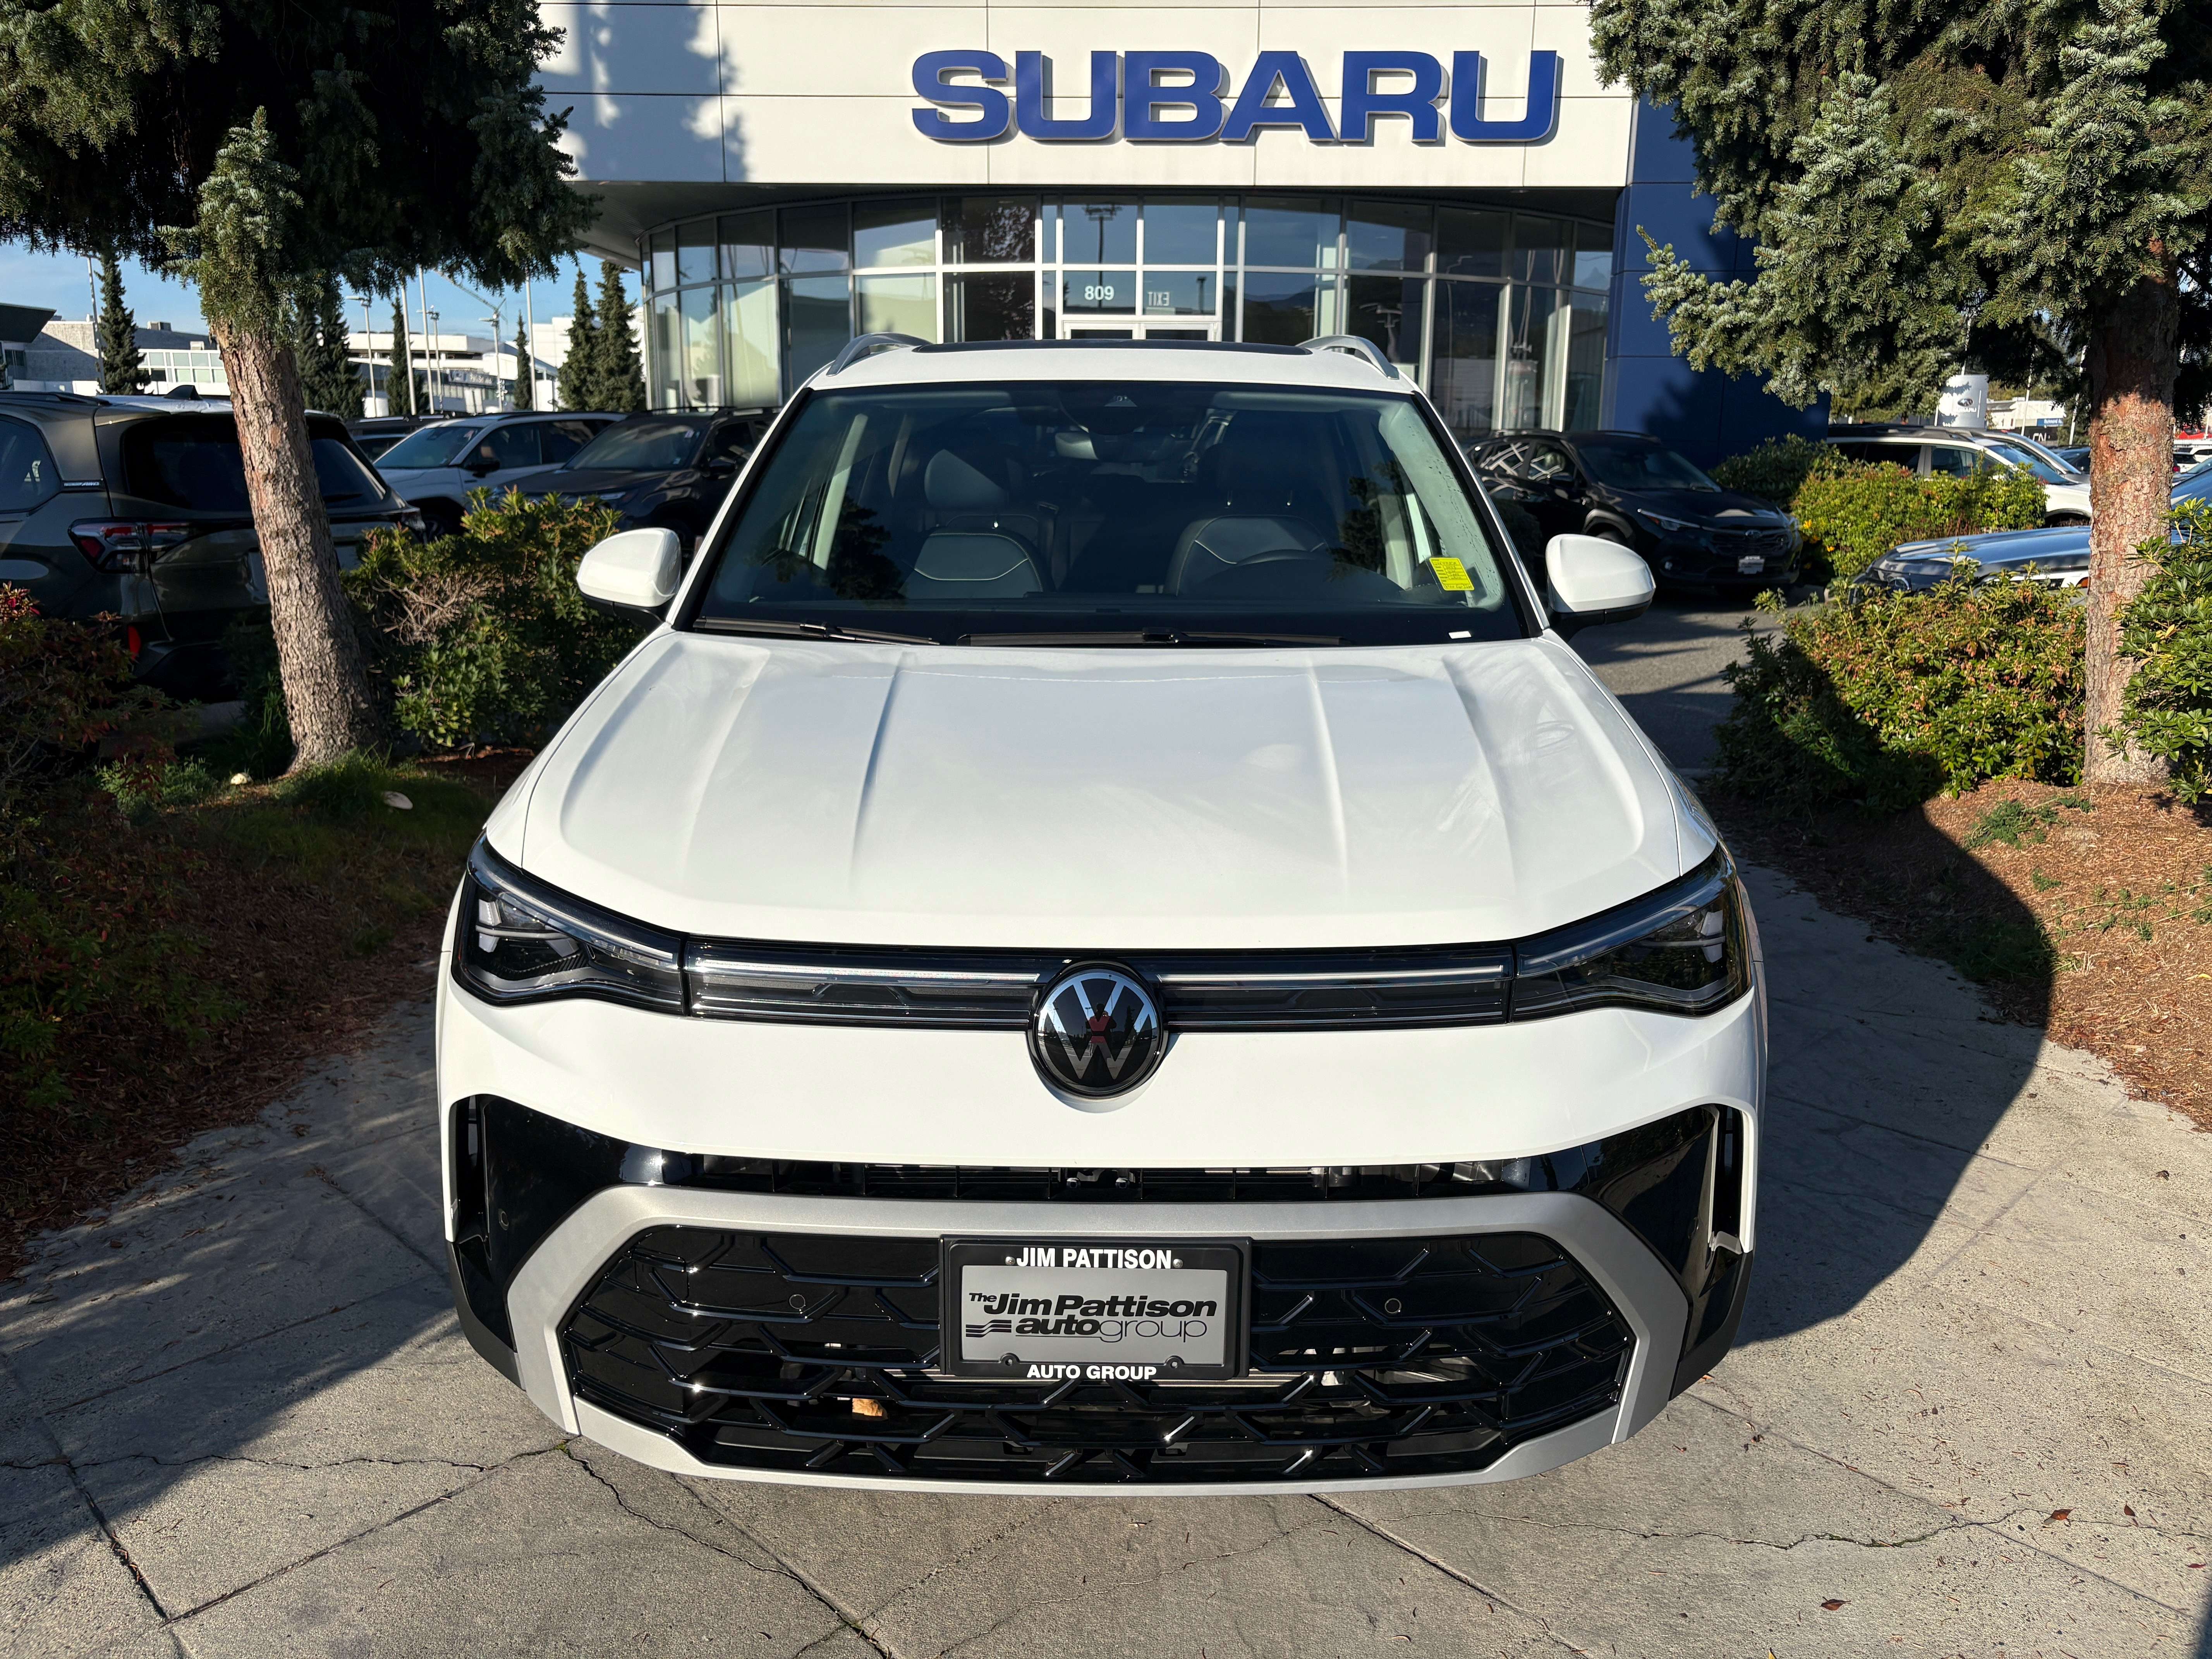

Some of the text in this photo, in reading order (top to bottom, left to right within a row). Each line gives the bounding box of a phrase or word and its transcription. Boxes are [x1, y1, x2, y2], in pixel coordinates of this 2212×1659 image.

[912, 49, 1558, 143] SUBARU
[1084, 286, 1114, 300] 809
[1016, 1248, 1172, 1270] JIM PATTISON
[969, 1293, 1217, 1318] The Jim Pattison
[1027, 1364, 1157, 1380] AUTO GROUP
